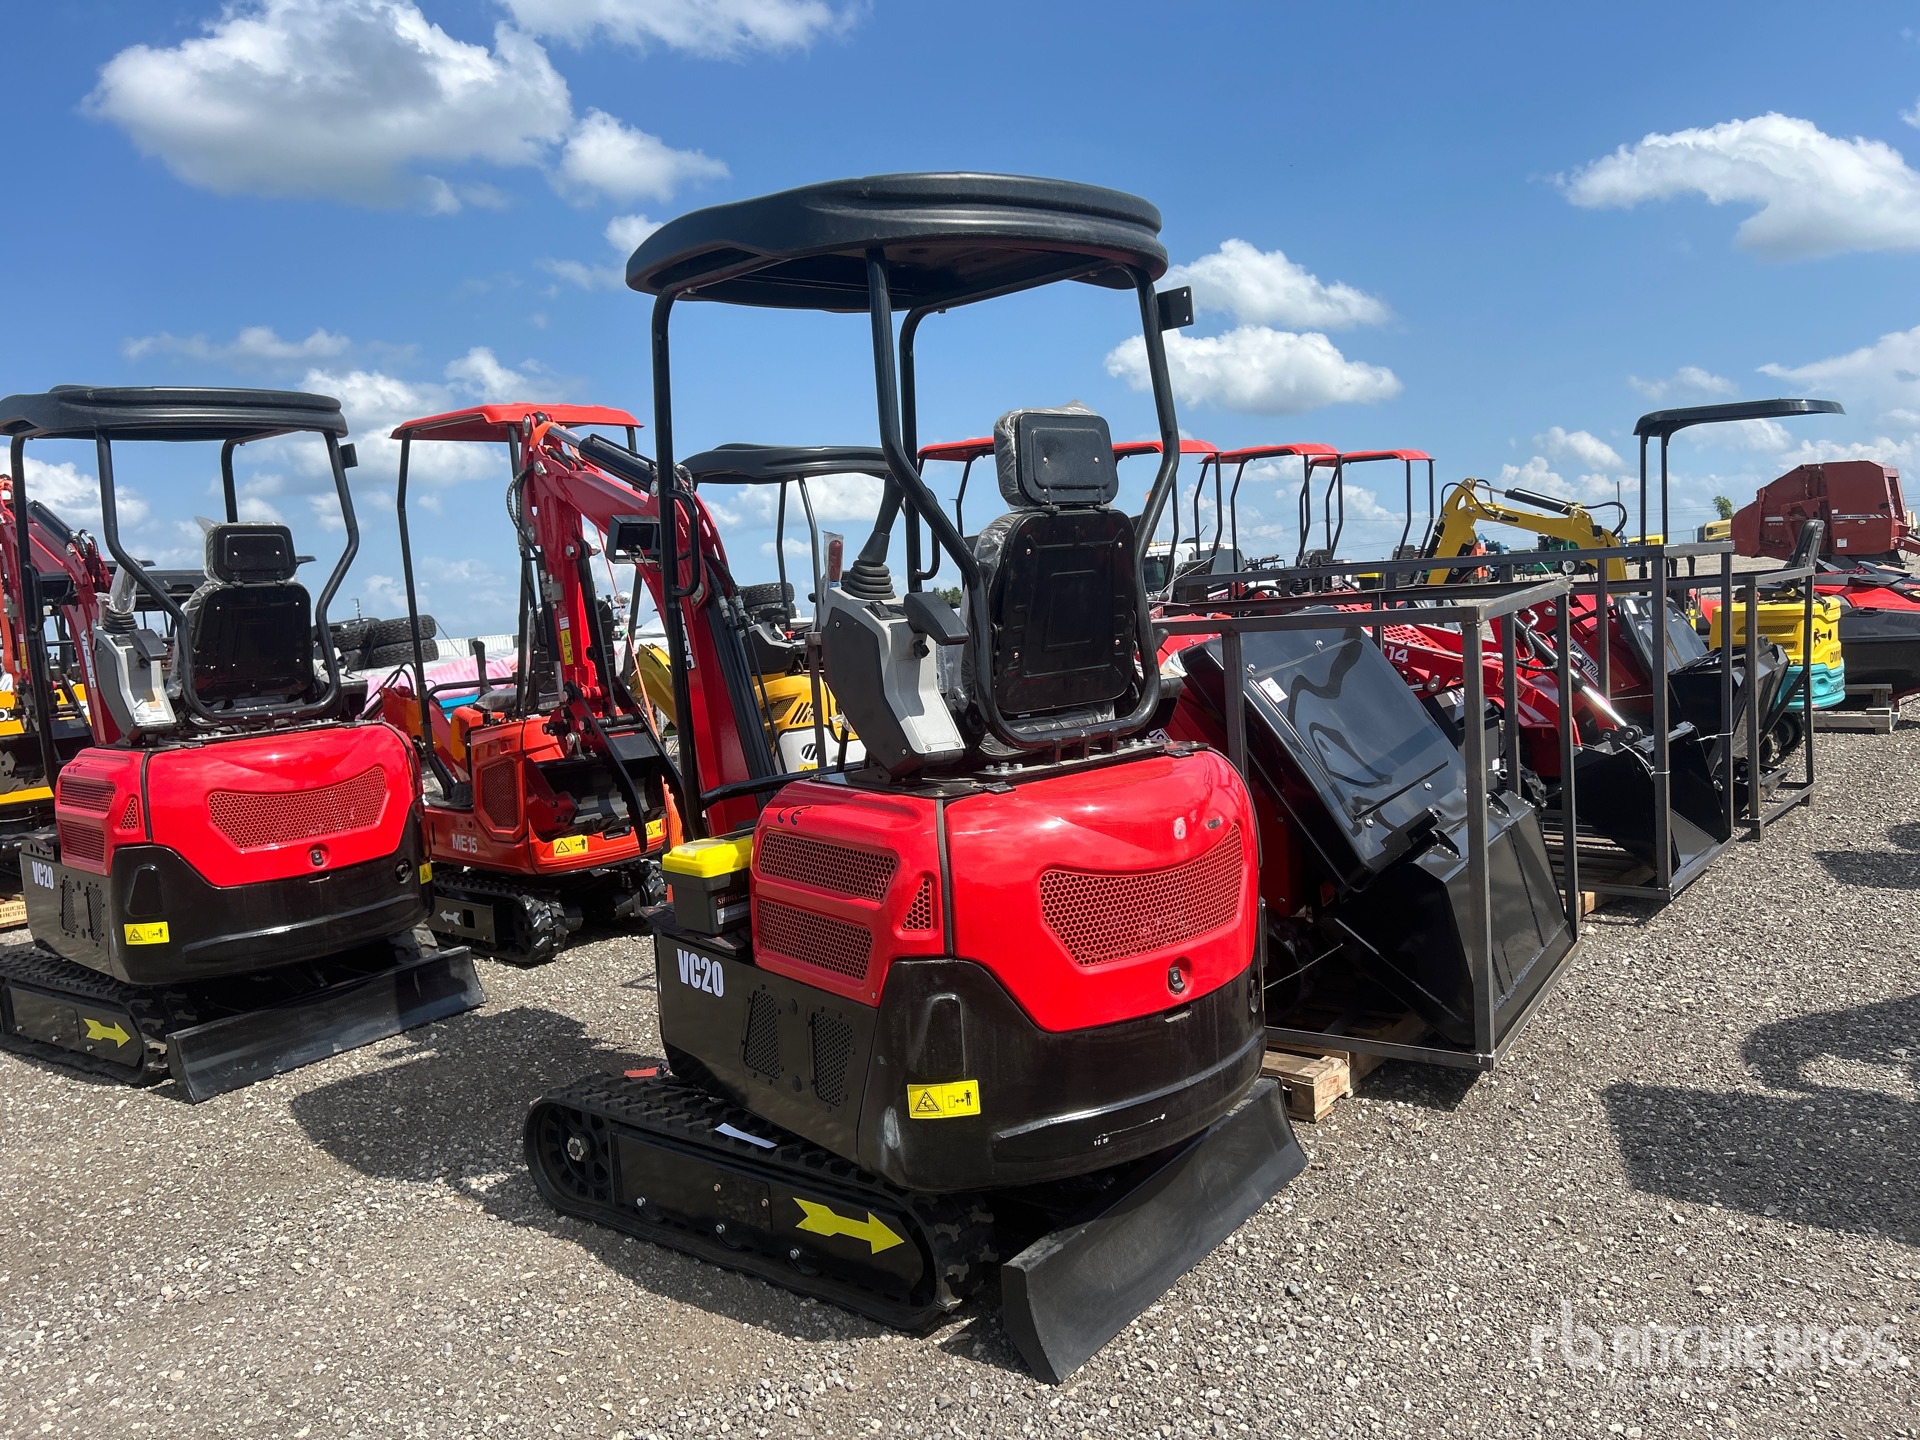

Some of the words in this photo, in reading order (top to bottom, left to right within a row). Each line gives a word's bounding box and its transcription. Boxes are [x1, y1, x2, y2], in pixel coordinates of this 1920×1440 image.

[452, 833, 478, 854] ME15
[32, 861, 55, 890] VC20
[676, 947, 725, 998] VC20
